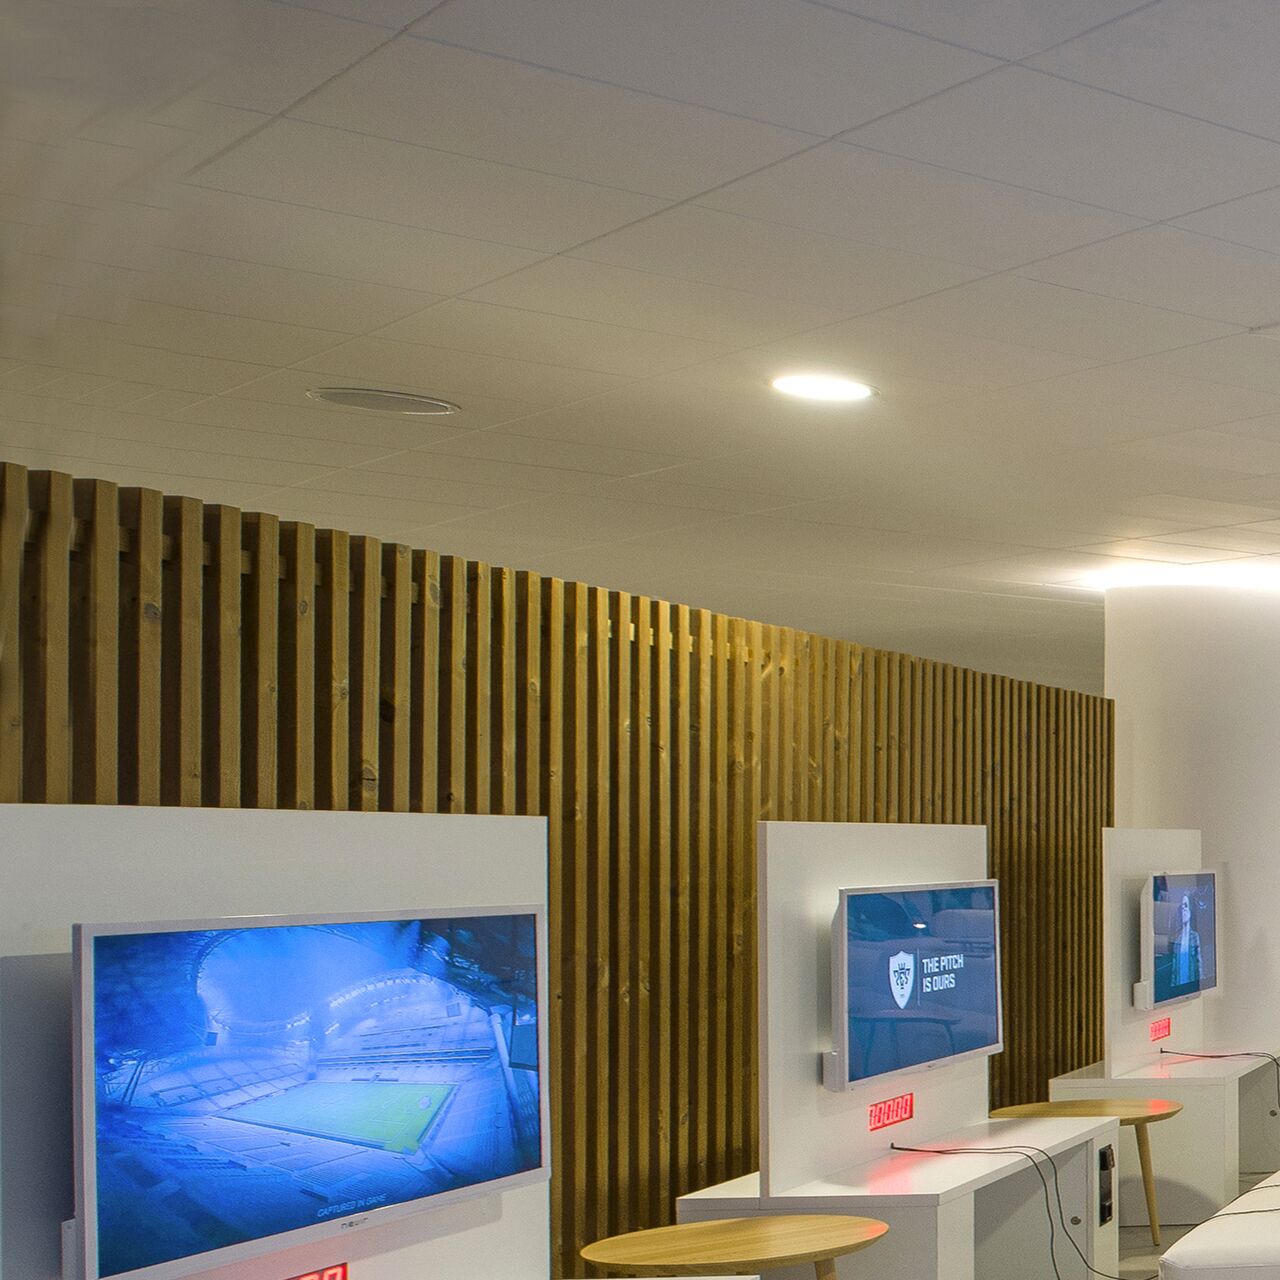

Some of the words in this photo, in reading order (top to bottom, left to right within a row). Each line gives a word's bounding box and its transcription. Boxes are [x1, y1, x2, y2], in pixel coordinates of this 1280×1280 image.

[922, 957, 939, 973] THE
[940, 953, 964, 972] PITCH
[922, 977, 932, 992] IS
[932, 973, 956, 991] OURS
